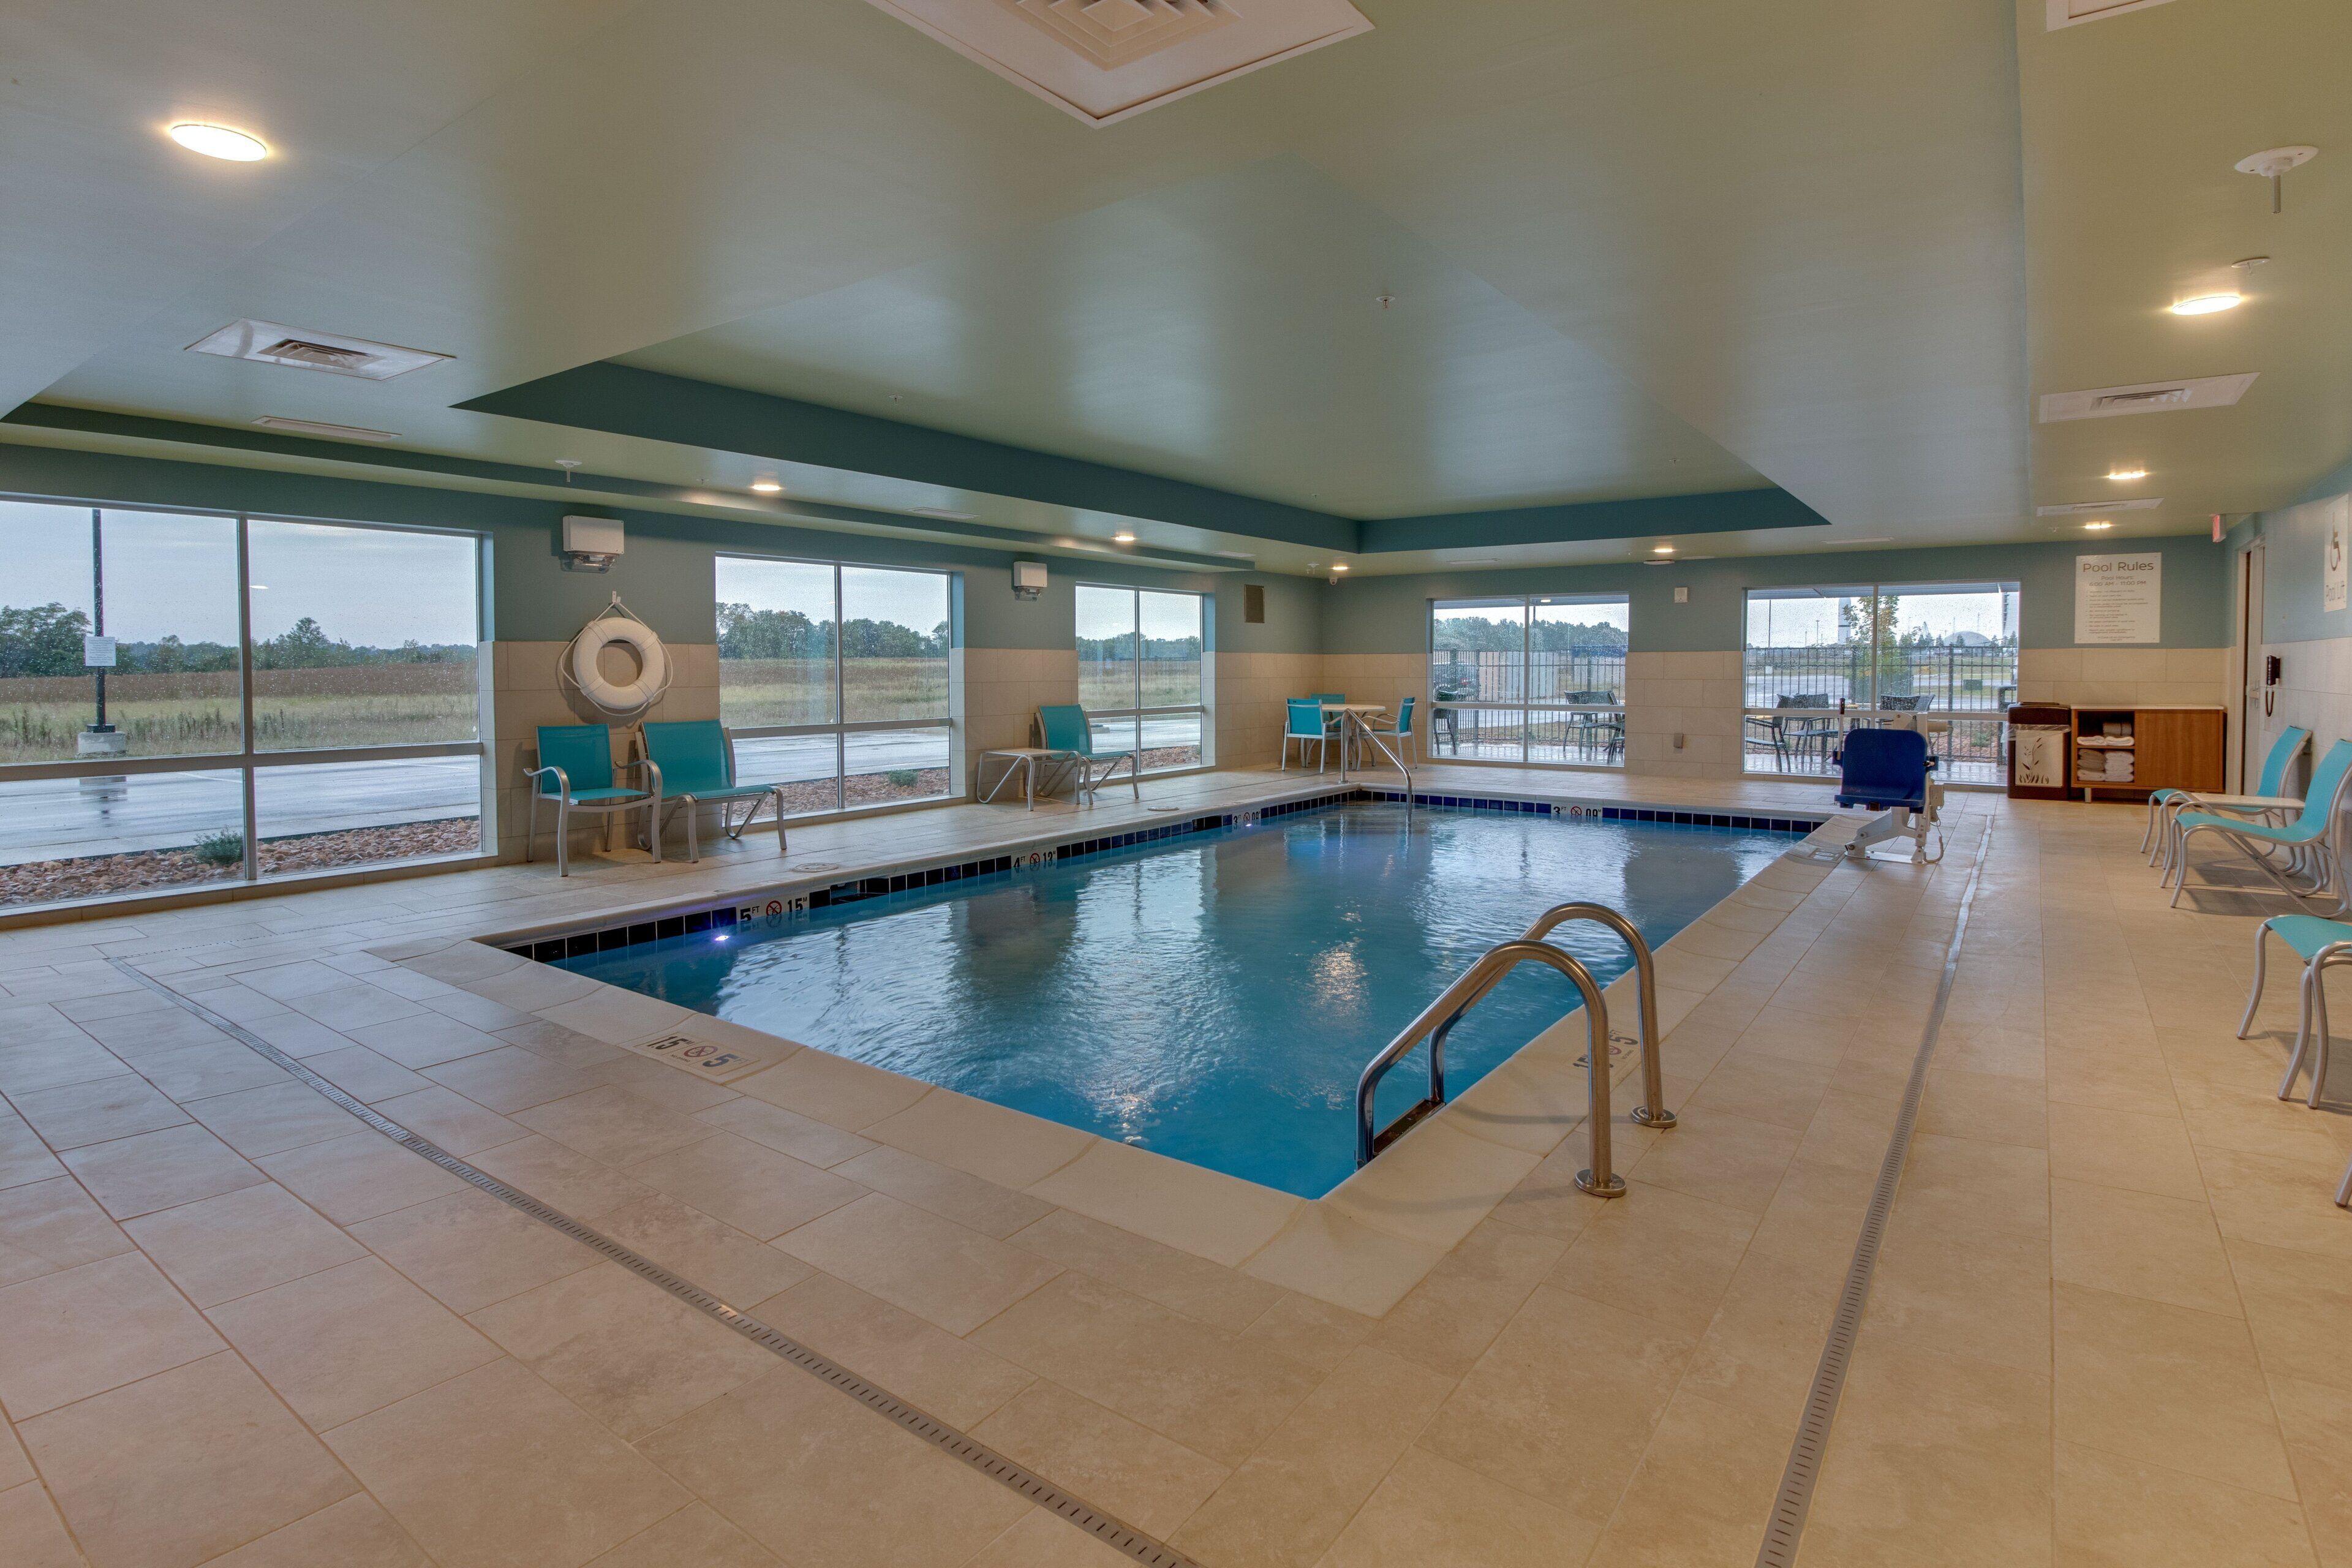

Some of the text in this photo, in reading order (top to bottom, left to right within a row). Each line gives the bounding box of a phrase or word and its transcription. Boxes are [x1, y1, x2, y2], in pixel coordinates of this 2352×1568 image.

[2083, 562, 2154, 572] Pool Rules
[2326, 581, 2345, 601] Pool Lift
